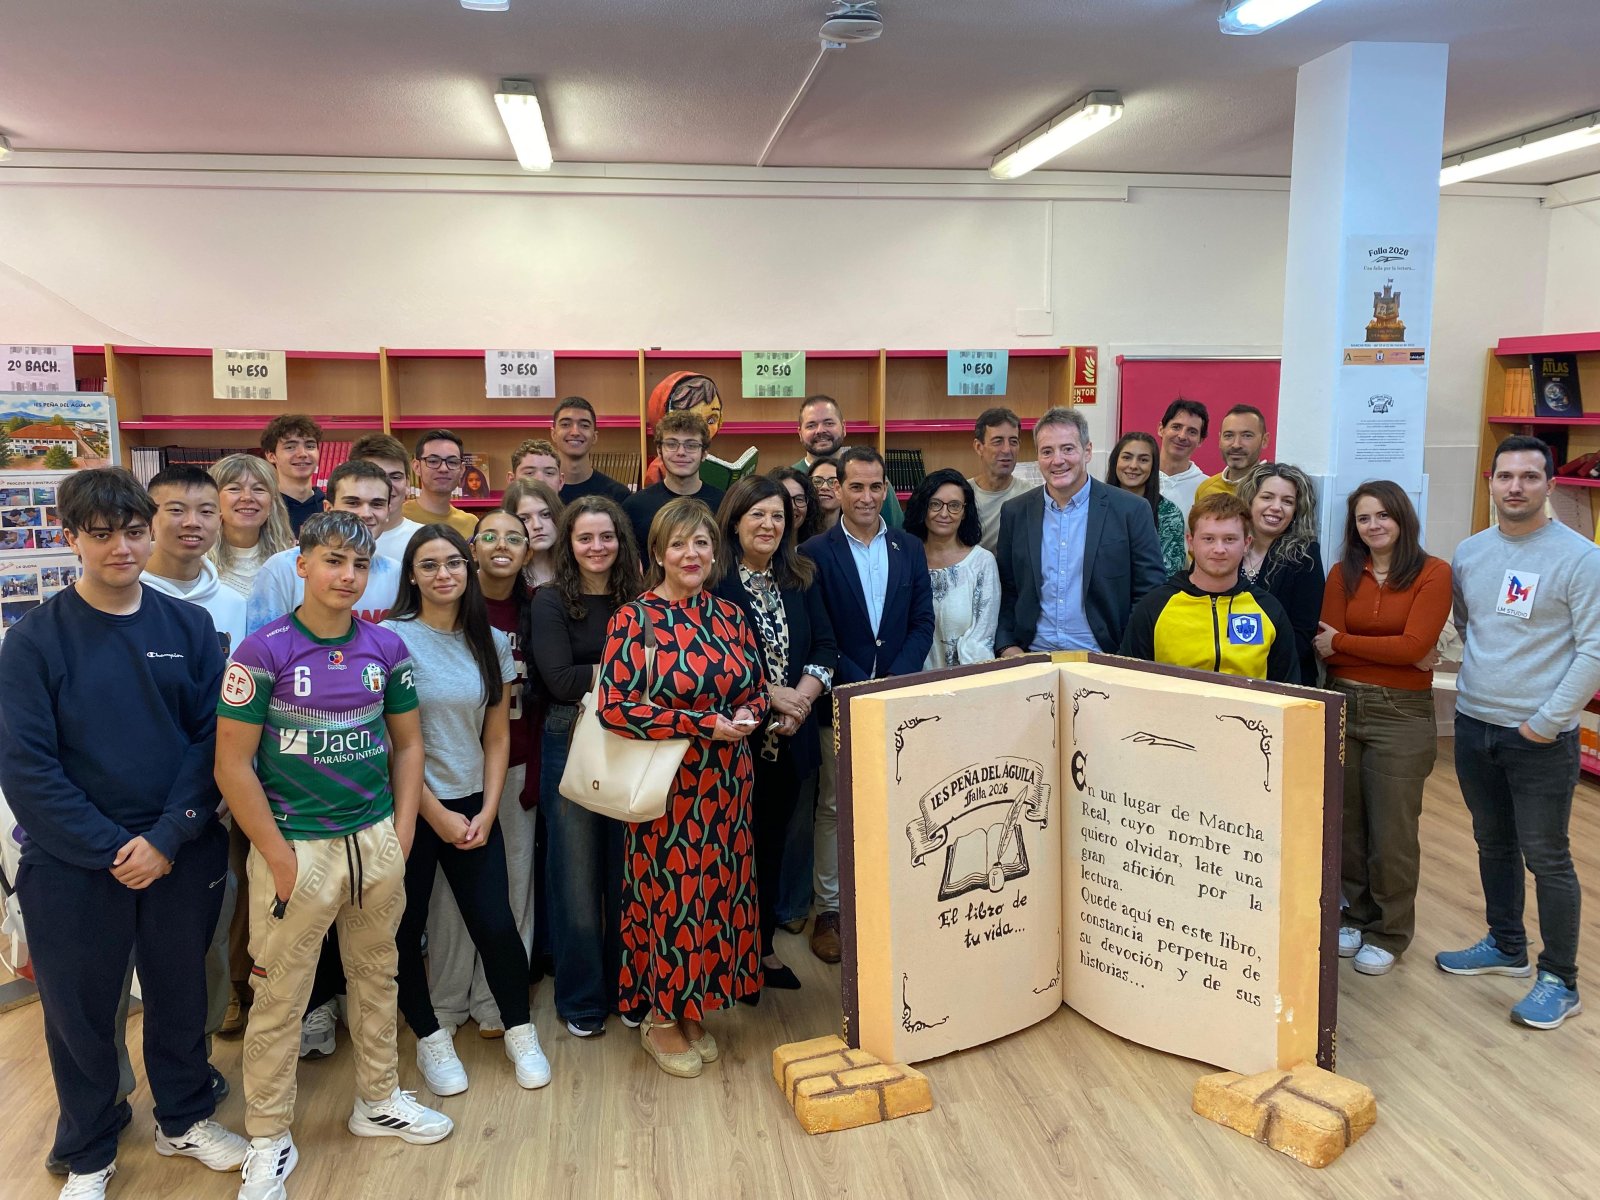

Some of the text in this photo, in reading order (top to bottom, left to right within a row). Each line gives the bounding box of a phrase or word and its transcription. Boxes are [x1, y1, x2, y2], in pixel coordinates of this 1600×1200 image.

[1368, 246, 1409, 256] Falla 2026
[25, 360, 61, 372] BACH.
[246, 364, 268, 378] ESO
[517, 364, 538, 376] ESO
[772, 364, 791, 376] ESO
[975, 364, 993, 374] ESO
[1542, 360, 1569, 373] ATLAS
[1506, 609, 1528, 618] STUDIO
[294, 666, 312, 697] 6
[313, 728, 370, 754] Jaén
[313, 744, 385, 764] PARAÍSO INTERIOR
[930, 761, 1036, 811] IES PEÑA DEL ÁGUILA
[964, 783, 1008, 808] Falla 2026
[1101, 790, 1116, 803] un
[1124, 792, 1161, 814] lugar
[1171, 805, 1190, 821] de
[1199, 811, 1264, 841] Mancha
[1082, 801, 1263, 863] Real, cuyo nombre no
[1081, 826, 1263, 888] quiero olvidar, late una
[1081, 864, 1123, 891] lectura.
[1081, 847, 1262, 911] gran afición por la
[938, 889, 1028, 929] El libro de
[964, 918, 1025, 948] tu vida...
[1081, 886, 1262, 962] Quede aquí en este libro,
[1080, 910, 1261, 981] constancia perpetua de
[1080, 949, 1145, 988] historias...
[1080, 931, 1261, 1007] su devoción y de sus
